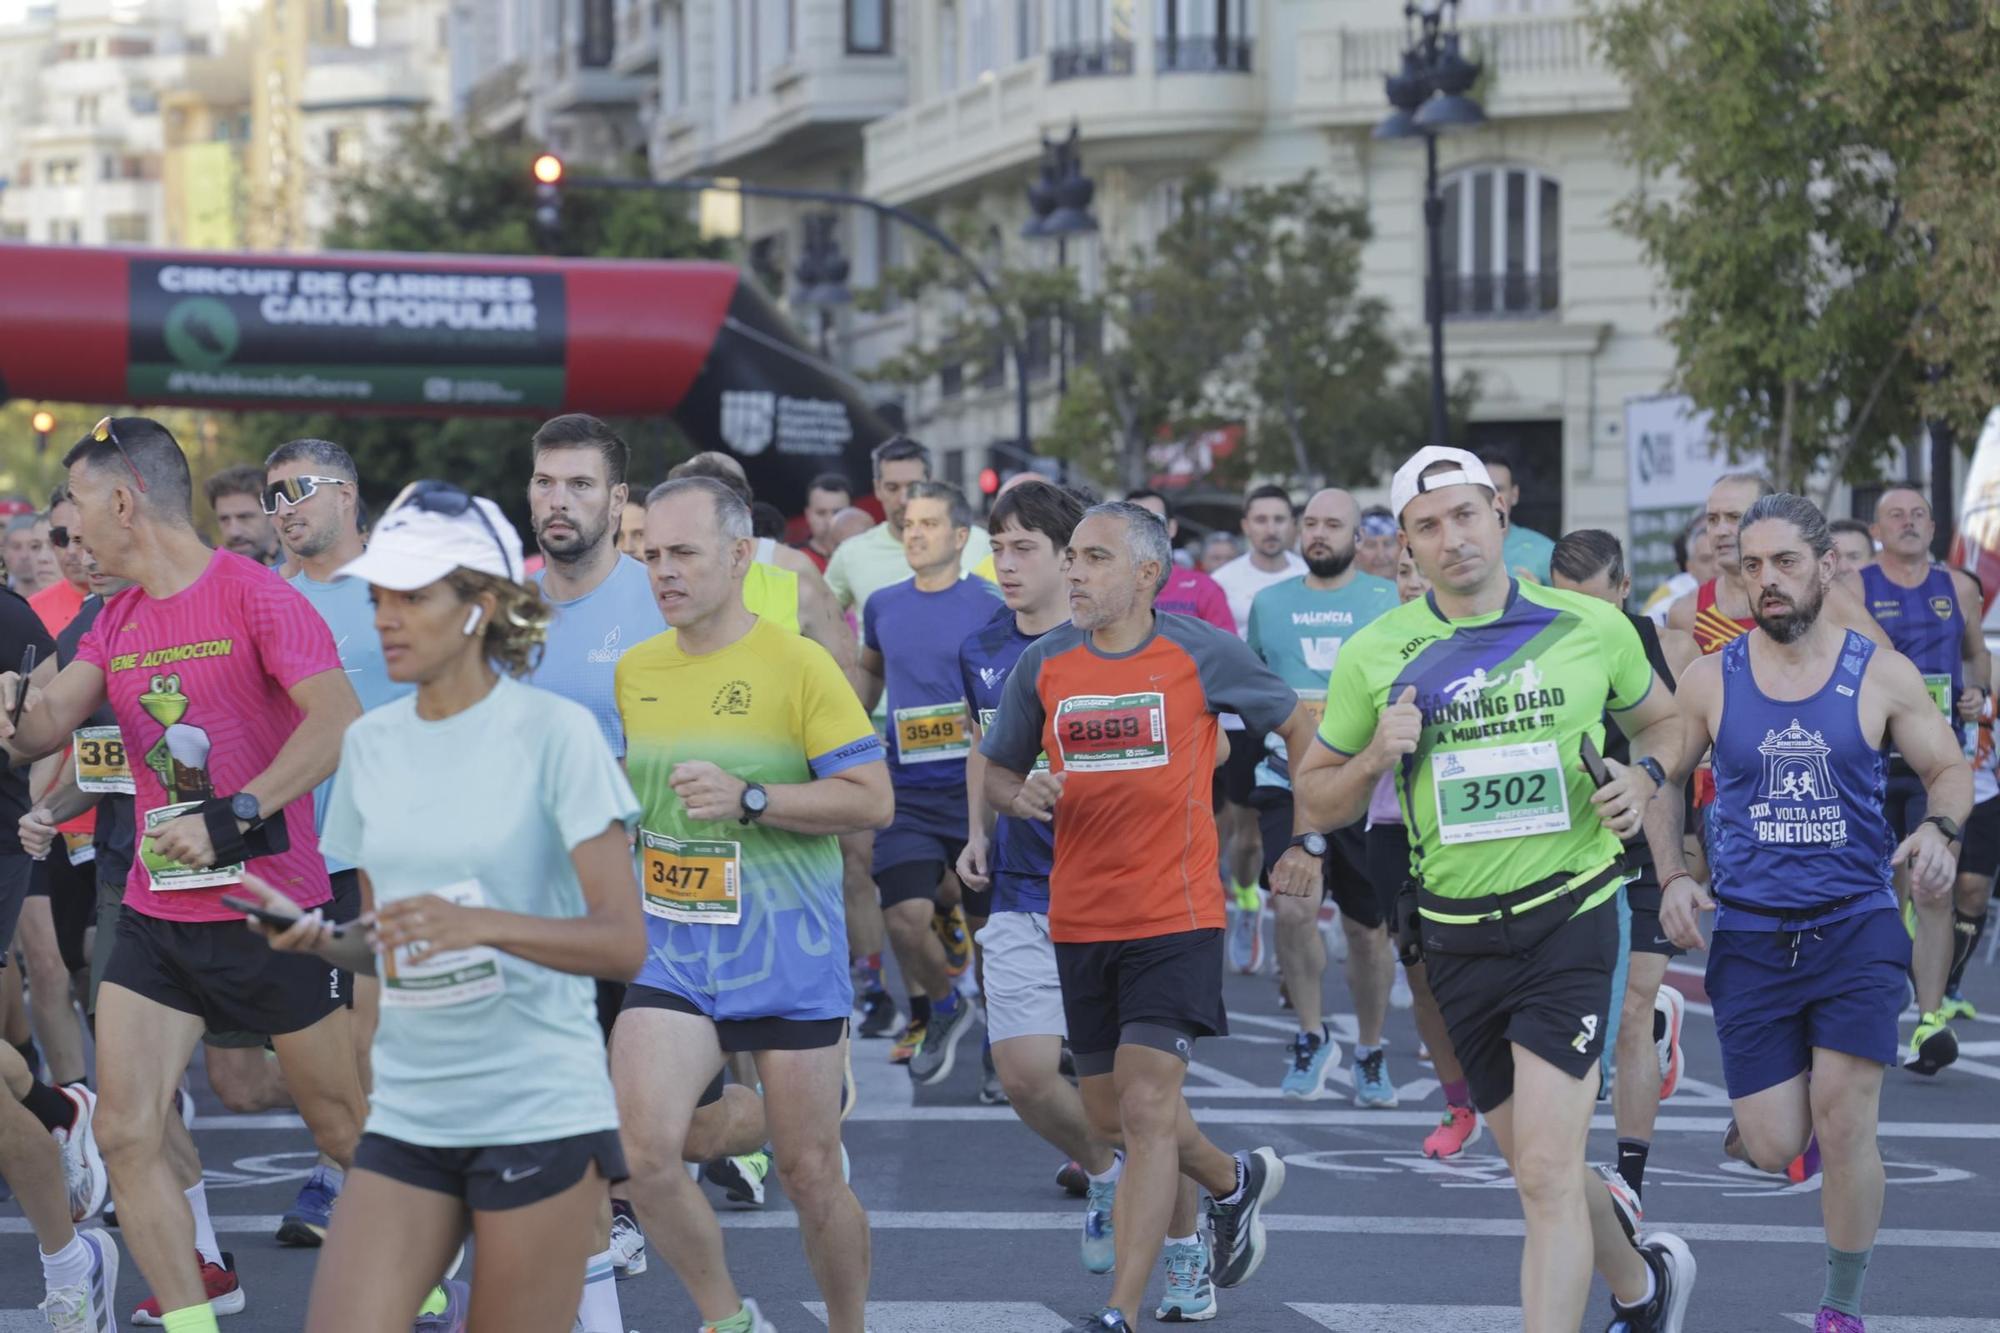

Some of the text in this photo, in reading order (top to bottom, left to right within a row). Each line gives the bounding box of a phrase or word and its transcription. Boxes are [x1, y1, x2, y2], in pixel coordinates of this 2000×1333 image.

[158, 265, 533, 300] CIRCUIT DE CARRERES
[375, 299, 537, 330] POPULAR
[1422, 695, 1509, 727] RUNNING
[1514, 688, 1566, 713] DEAD
[906, 722, 953, 740] 3549
[1069, 717, 1139, 741] 2899
[1436, 731, 1448, 744] A
[1541, 714, 1555, 727] !!!
[1461, 774, 1546, 812] 3502
[1749, 802, 1840, 821] XXIX VOLTA A PEU
[1753, 820, 1848, 843] A BENETÚSSER
[652, 860, 709, 889] 3477
[330, 968, 340, 999] FILA
